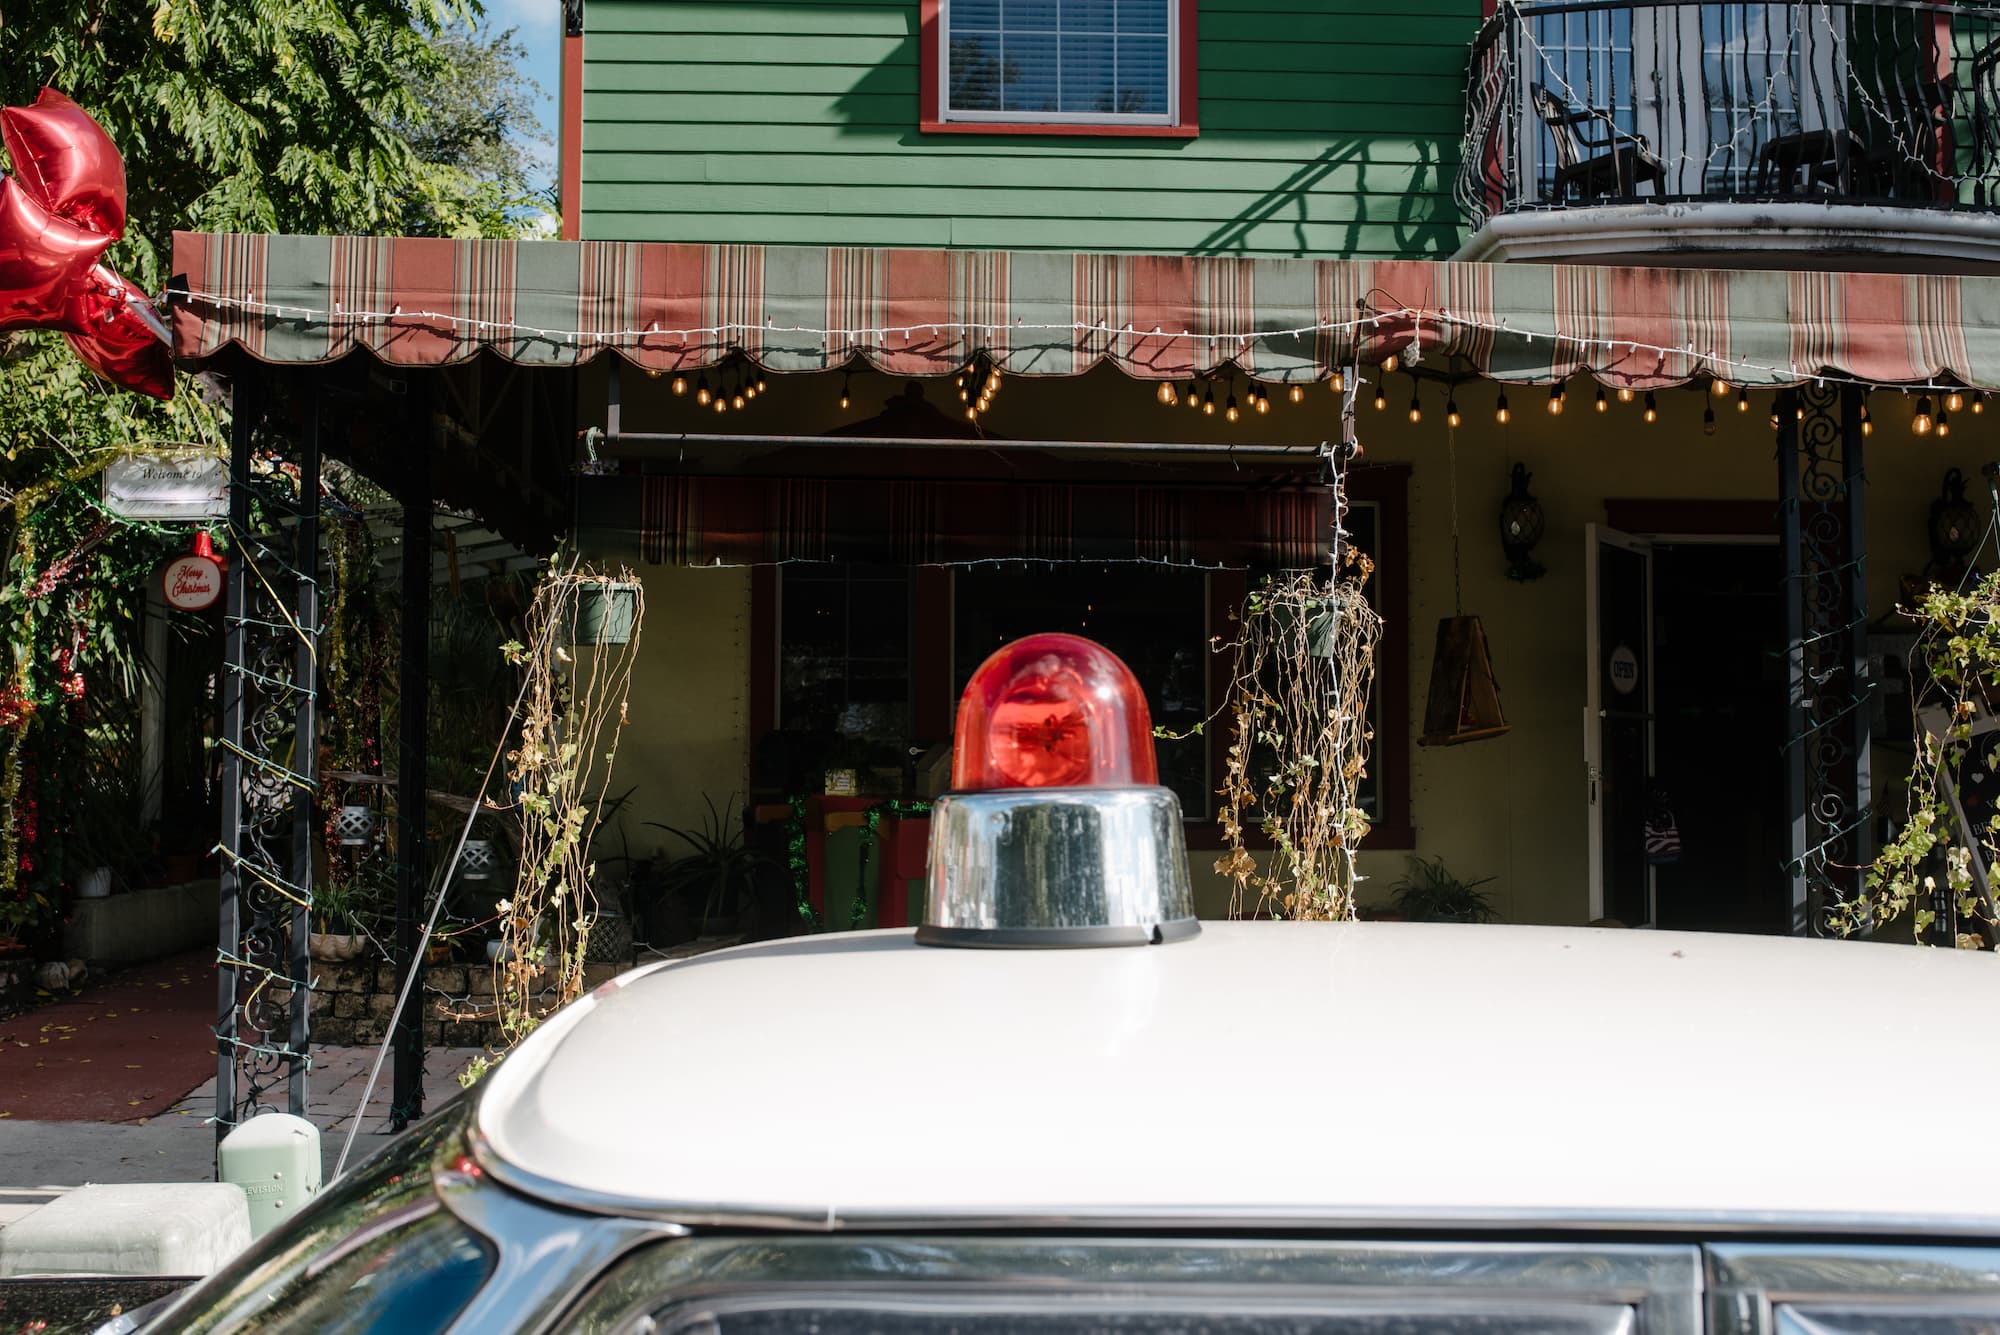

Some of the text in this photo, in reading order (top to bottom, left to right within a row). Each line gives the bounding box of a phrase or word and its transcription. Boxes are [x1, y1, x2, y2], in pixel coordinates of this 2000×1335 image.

[143, 467, 202, 479] Welcome to
[177, 565, 204, 580] Merry
[172, 581, 211, 598] Christmas
[1614, 661, 1634, 678] OPEN
